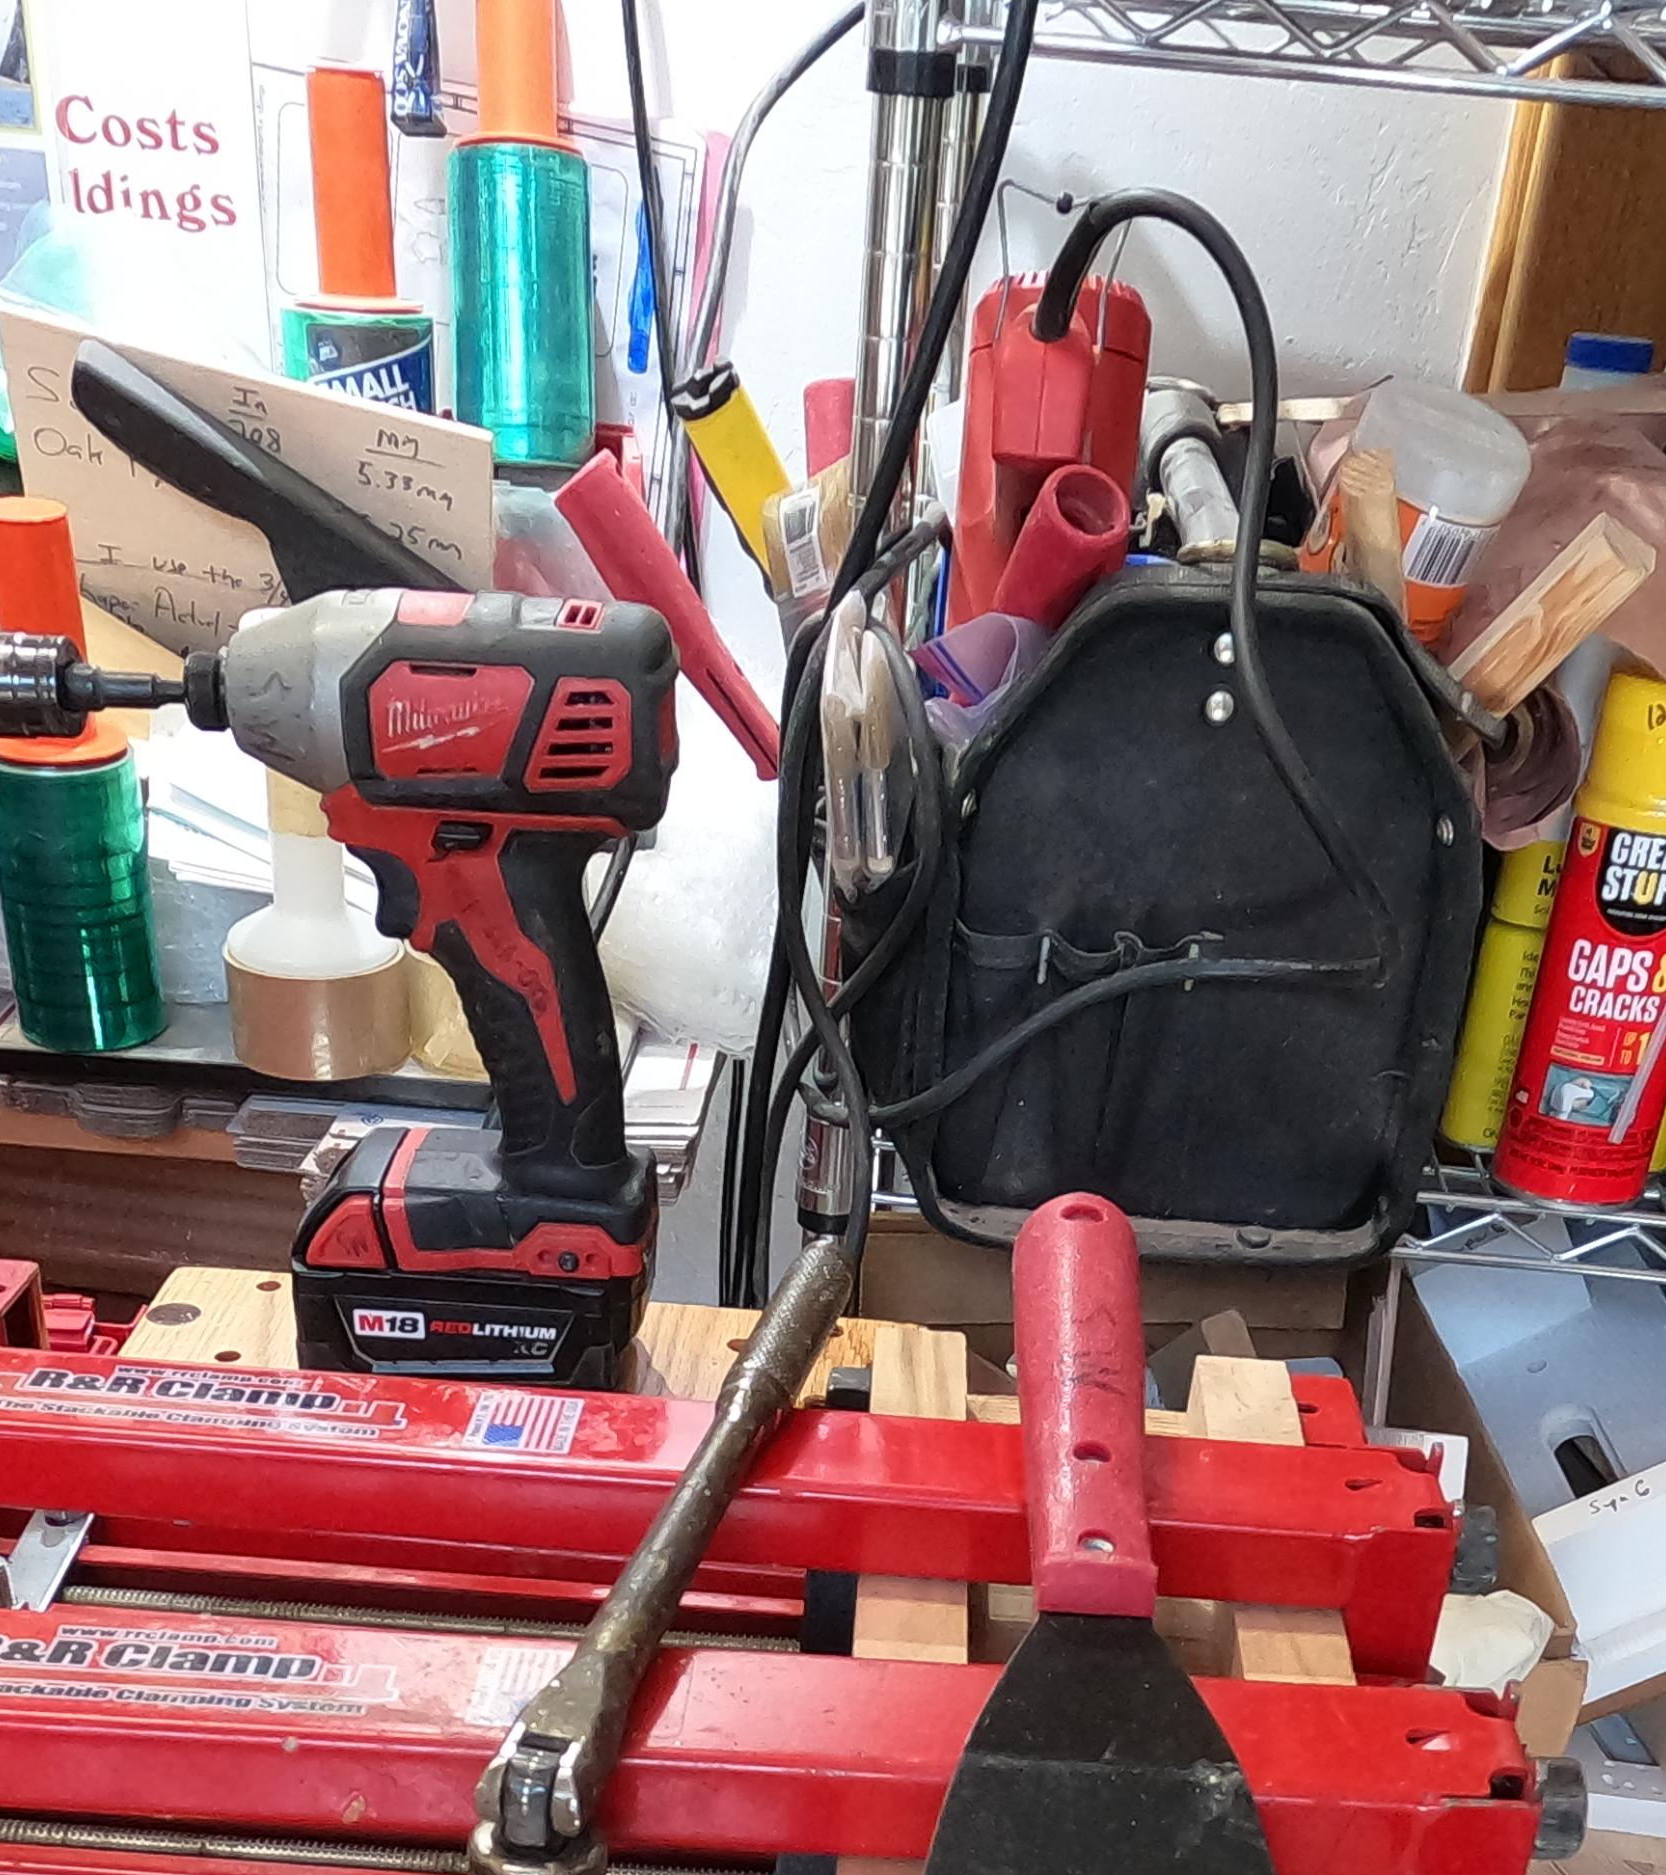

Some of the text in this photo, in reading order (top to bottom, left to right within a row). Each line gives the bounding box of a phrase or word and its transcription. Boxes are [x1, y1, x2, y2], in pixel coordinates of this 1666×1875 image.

[55, 94, 220, 155] Costs
[1568, 939, 1654, 993] GAPS
[1568, 985, 1661, 1024] CRACKS
[357, 1312, 558, 1341] M18 REDLITHIUM
[30, 1368, 341, 1411] R&R Clamp
[60, 1626, 276, 1648] www.rrclamp.com
[104, 1644, 319, 1682] Clamp
[115, 1688, 253, 1710] Clamping
